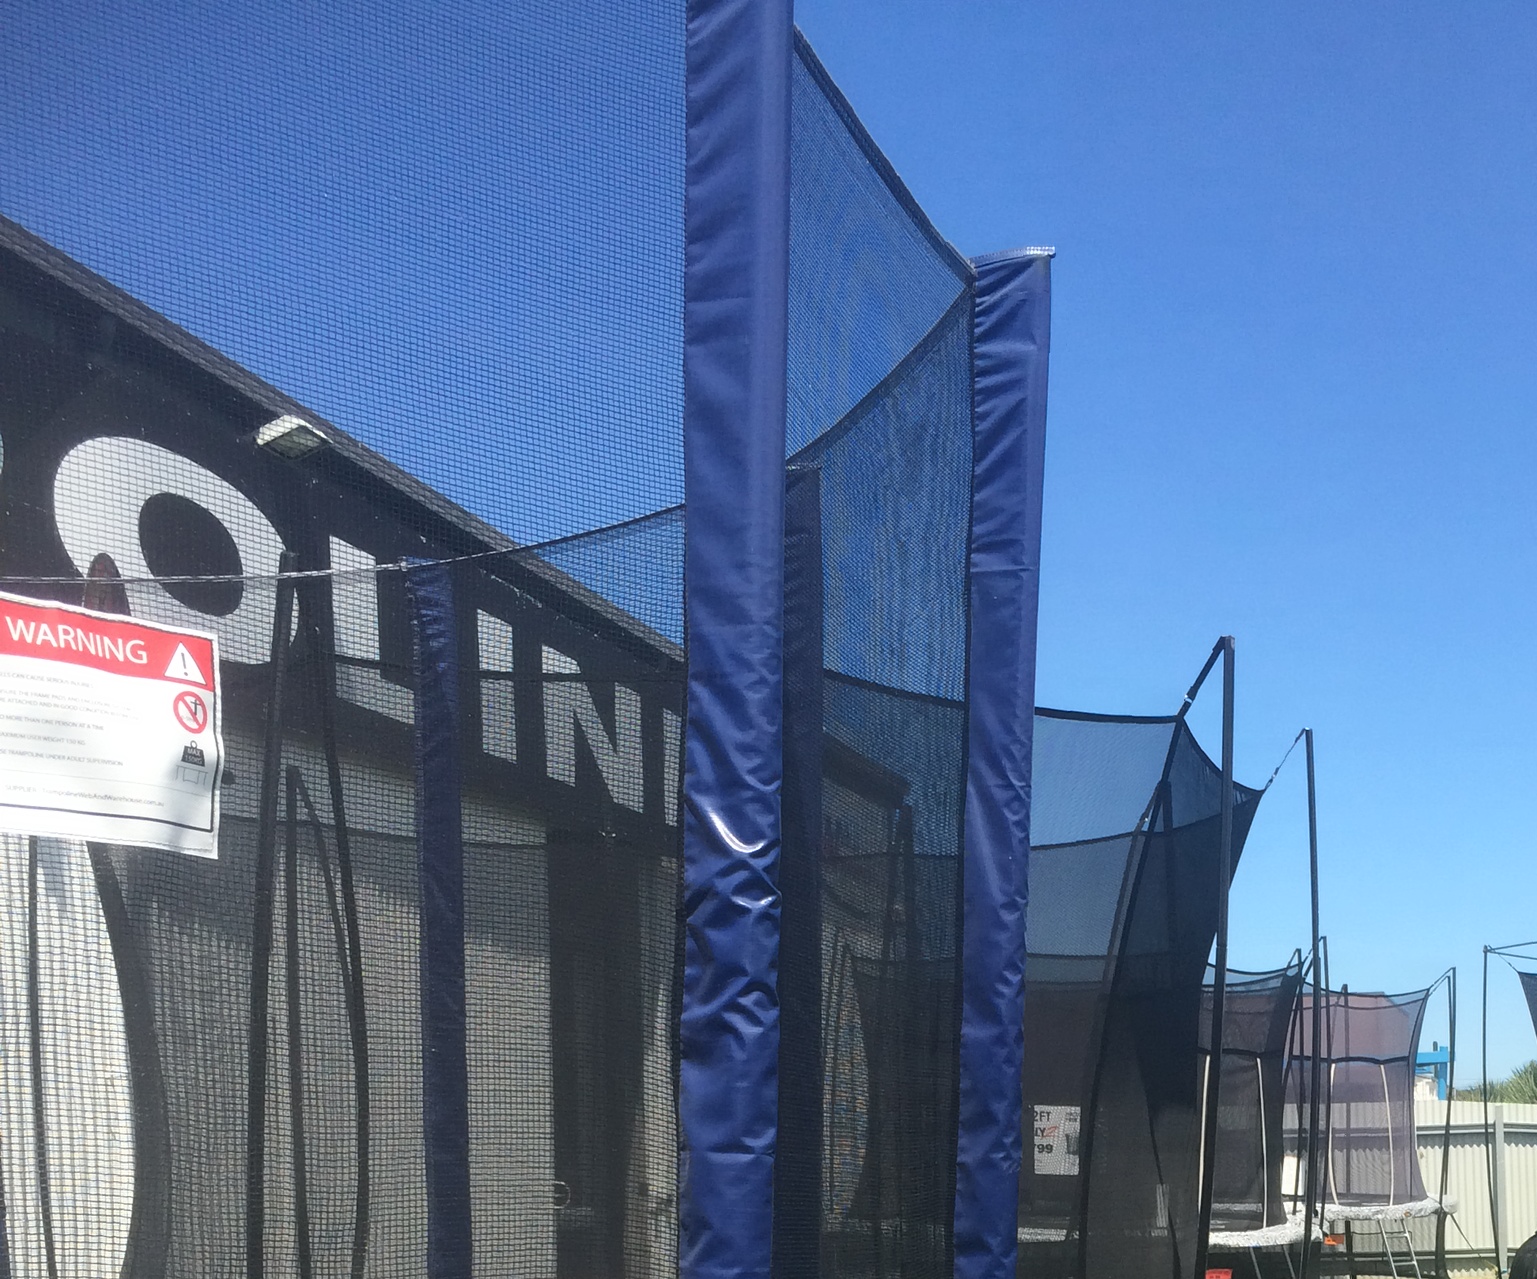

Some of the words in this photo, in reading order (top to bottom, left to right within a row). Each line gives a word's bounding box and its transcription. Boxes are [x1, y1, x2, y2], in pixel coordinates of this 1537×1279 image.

[0, 425, 684, 828] OLIN
[5, 616, 148, 664] WARNING
[187, 748, 201, 757] MAX
[1034, 1143, 1054, 1154] 99
